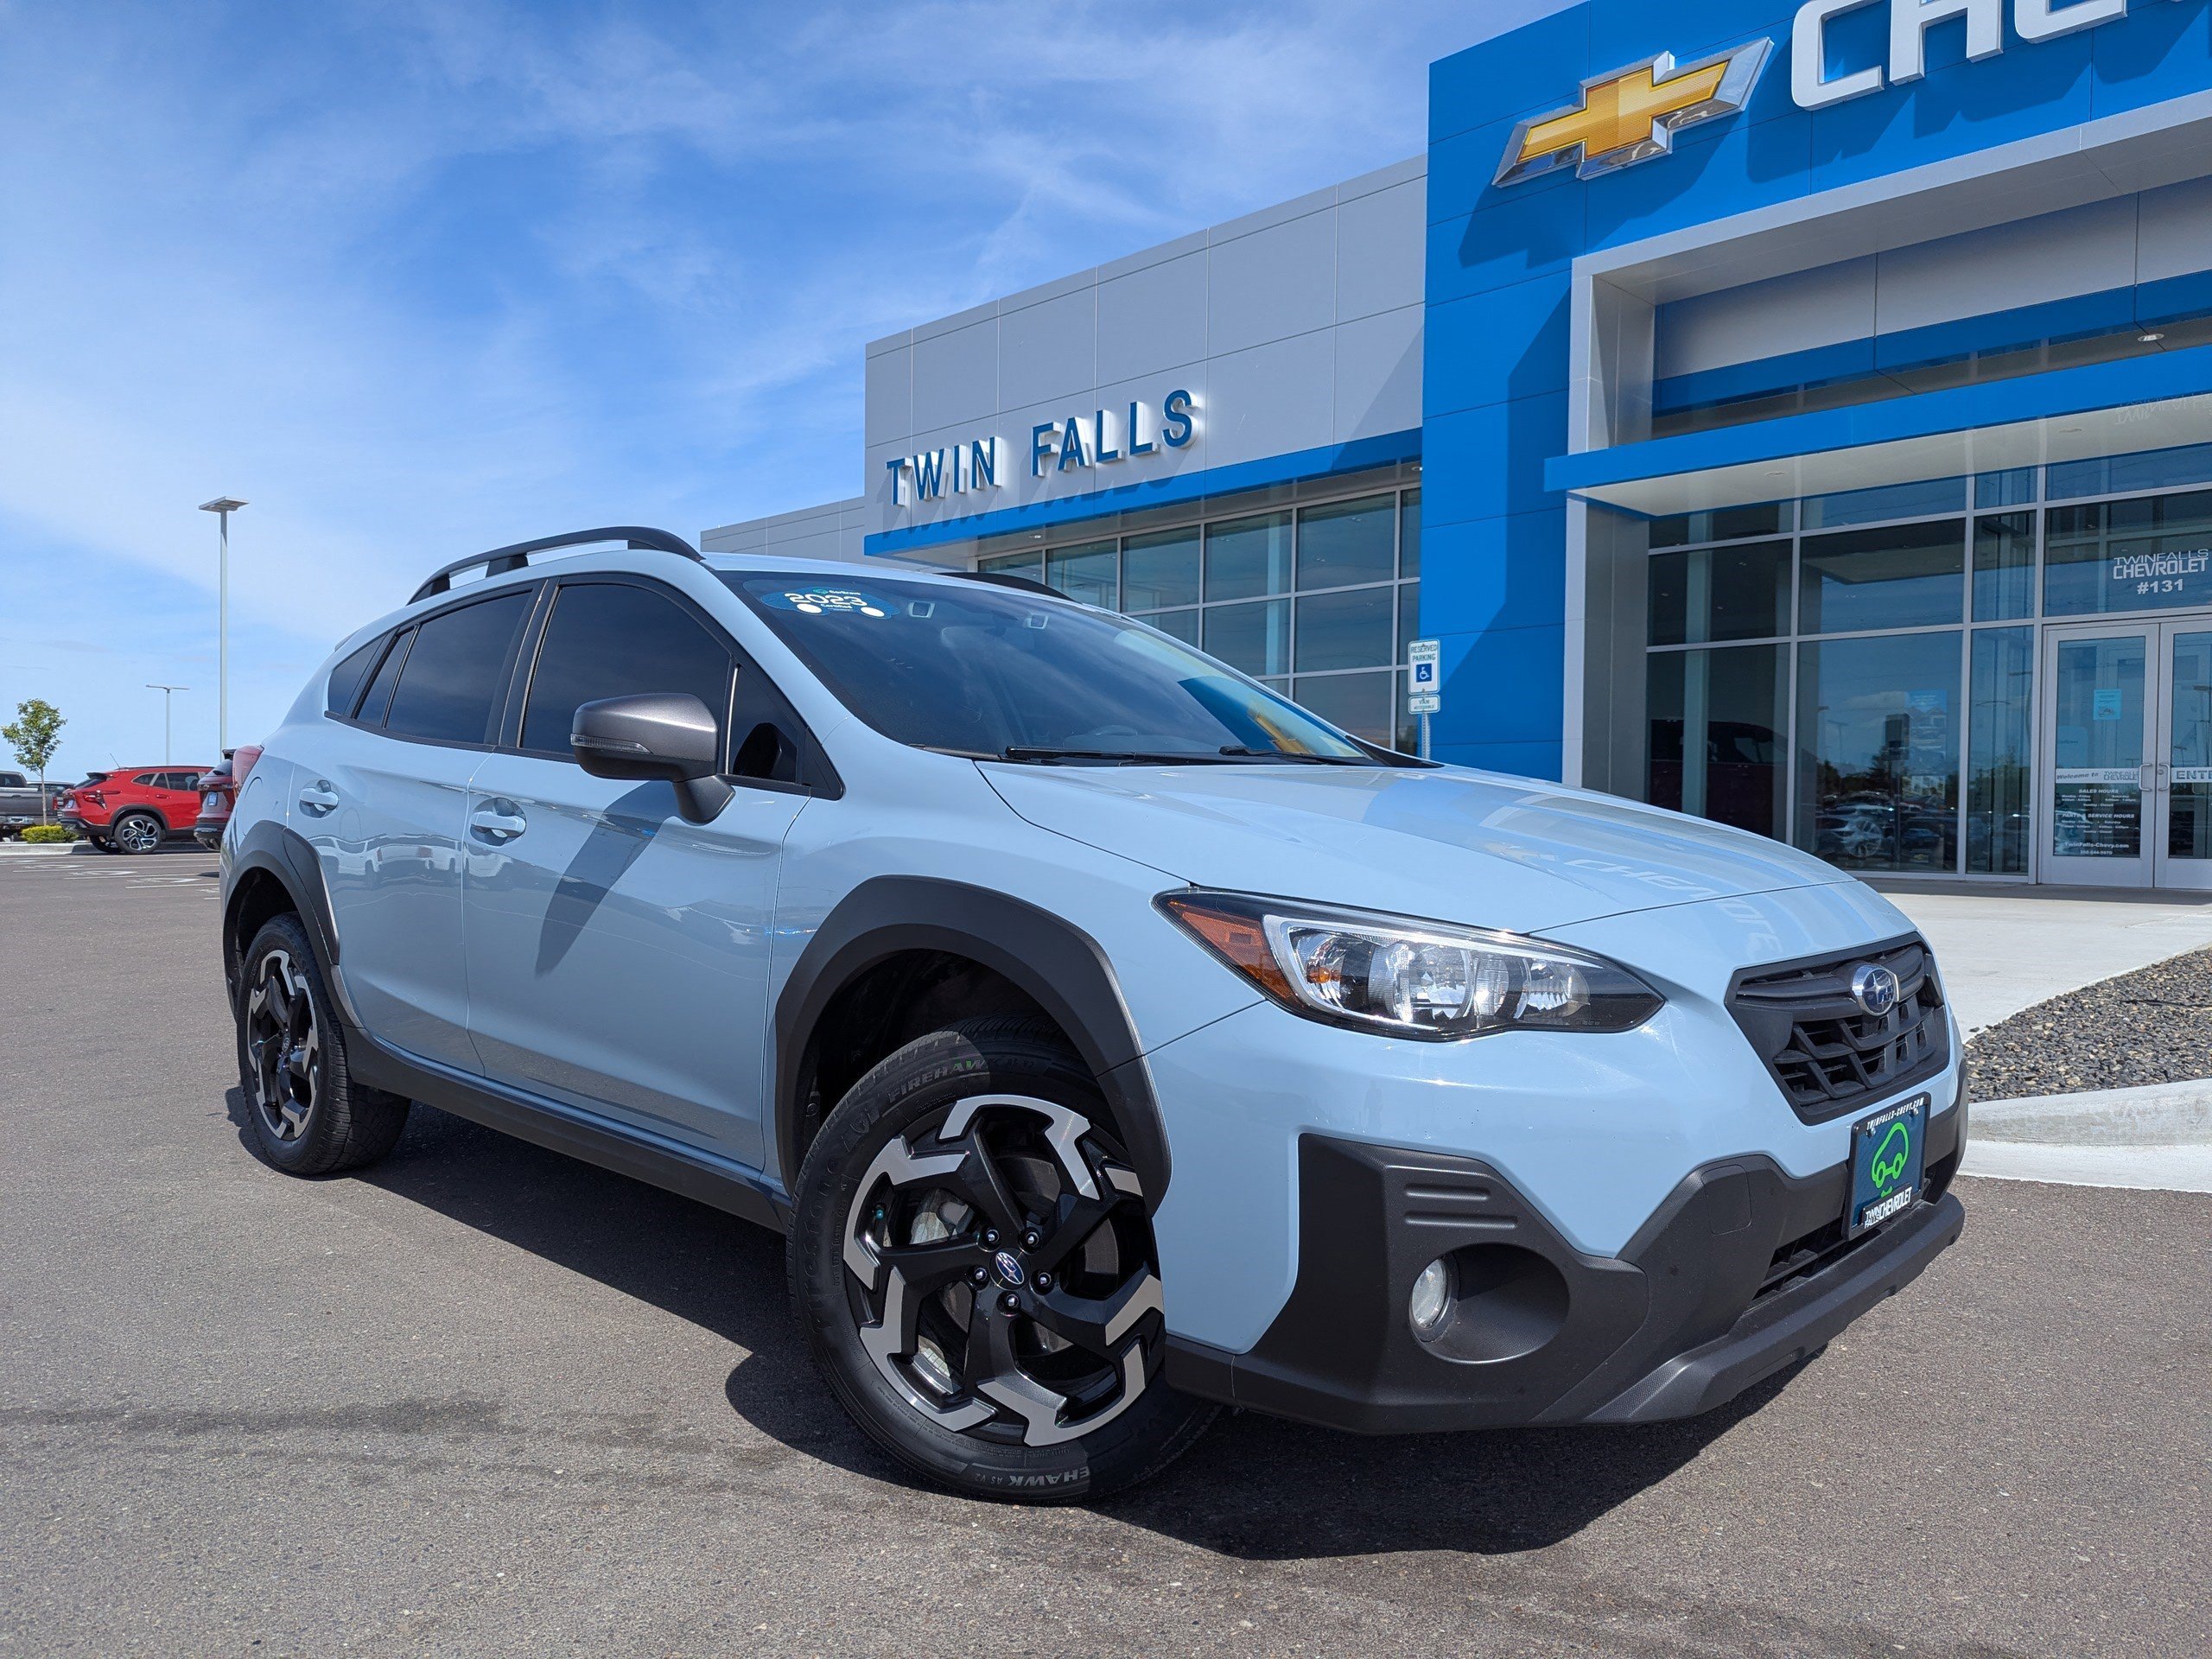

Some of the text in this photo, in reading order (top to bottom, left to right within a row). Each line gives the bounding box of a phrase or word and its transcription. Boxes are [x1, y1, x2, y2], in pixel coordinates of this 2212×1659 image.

[886, 389, 1203, 506] TWIN FALLS
[2113, 557, 2209, 580] CHEVROLET
[2137, 578, 2184, 594] #131
[785, 593, 868, 606] 2023
[1410, 644, 1437, 653] RESERVED
[1878, 1185, 1912, 1220] CHEVROLET
[976, 1467, 1090, 1487] EHAWK AS V2
